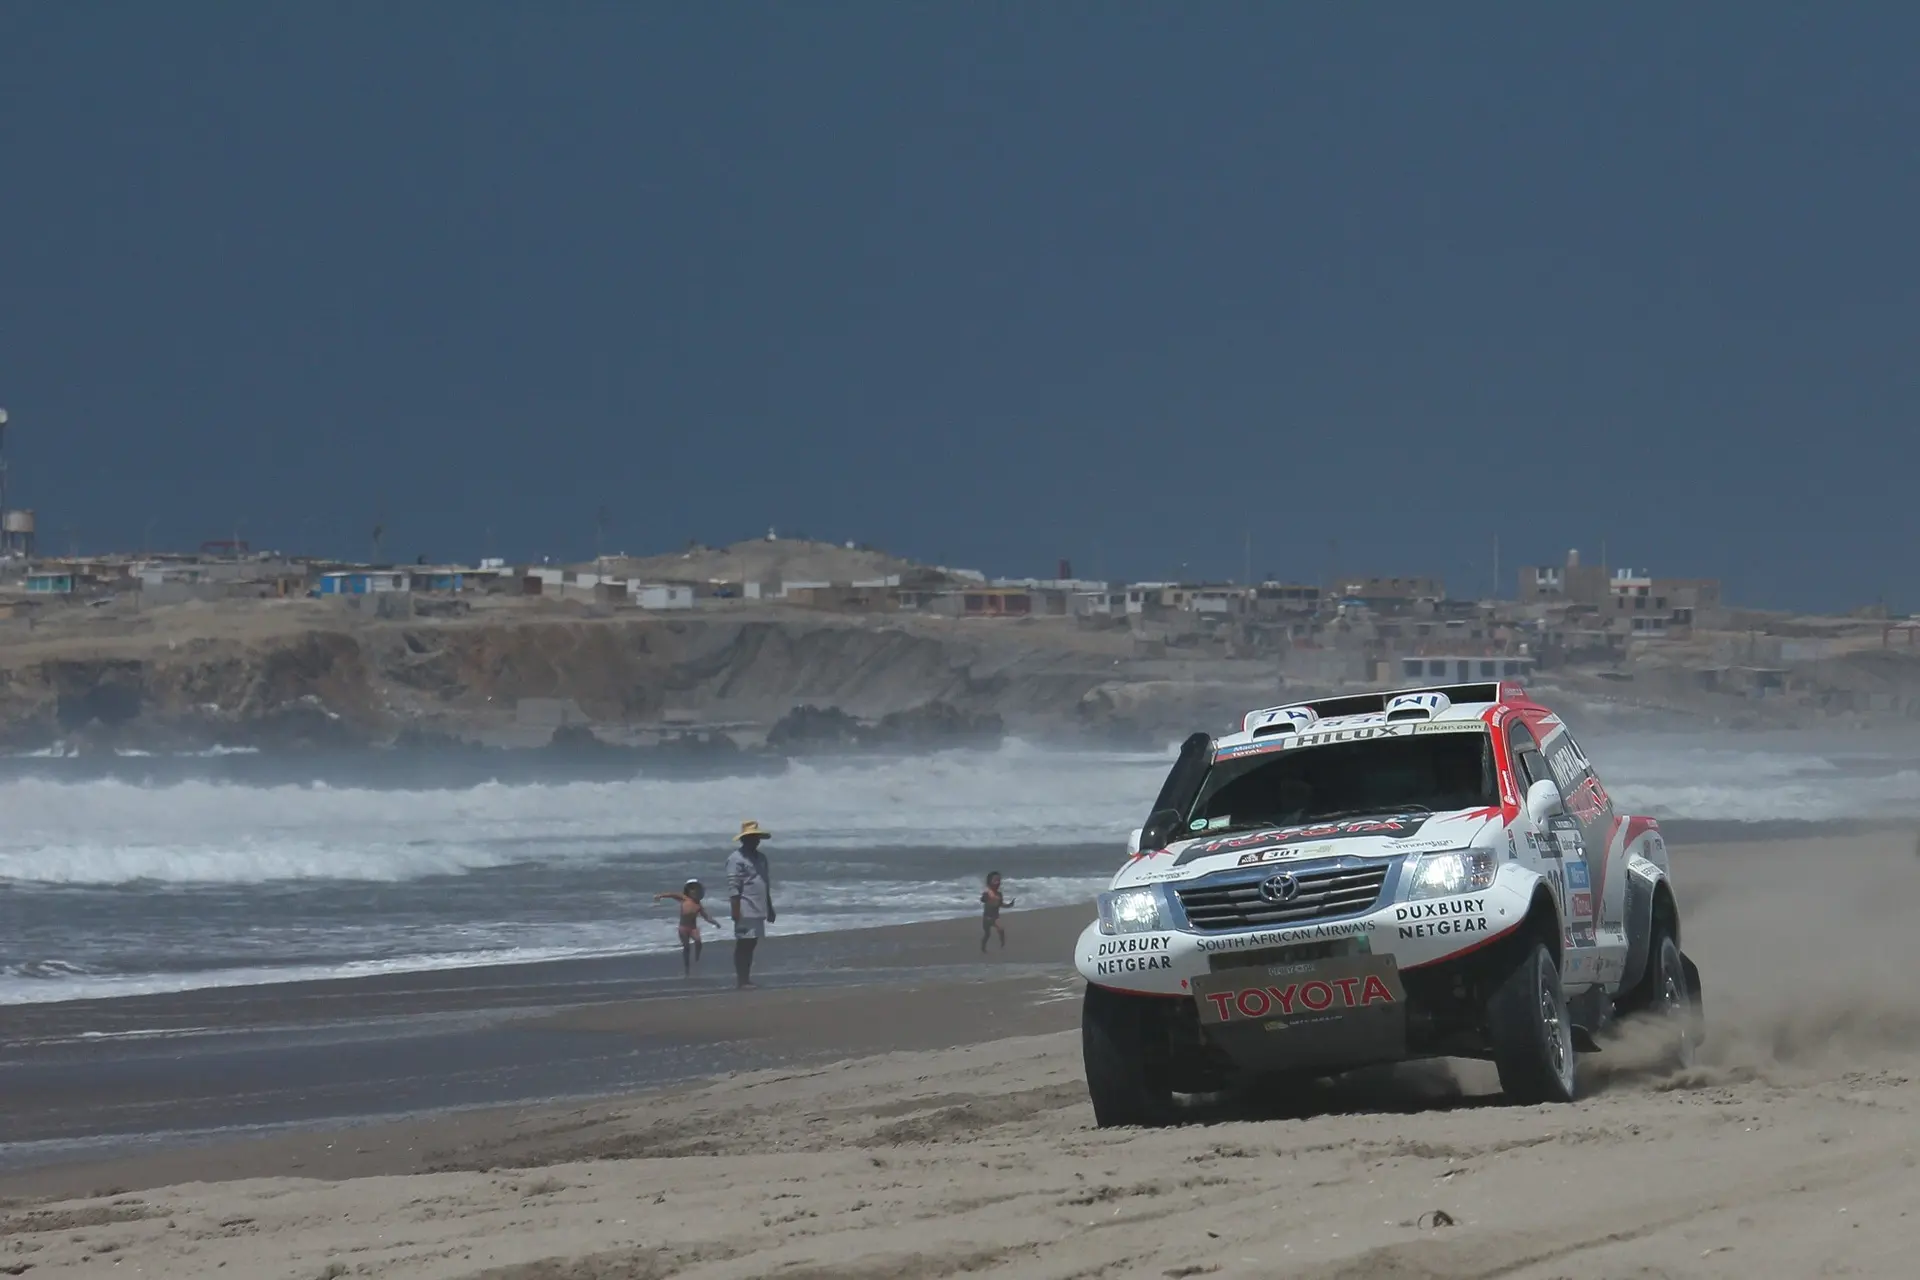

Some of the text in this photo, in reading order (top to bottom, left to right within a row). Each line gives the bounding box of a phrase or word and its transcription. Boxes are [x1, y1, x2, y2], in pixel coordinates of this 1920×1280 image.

[1296, 726, 1399, 747] HILUX
[1419, 723, 1482, 732] dakar.com
[1231, 748, 1263, 758] TOTAL
[1268, 849, 1300, 859] 301
[1396, 899, 1486, 920] DUXBURY
[1196, 919, 1376, 952] SOUTH AFRICAN AIRWAYS
[1398, 917, 1489, 939] NETGEAR
[1098, 936, 1171, 956] DUXBURY
[1097, 955, 1172, 976] NETGEAR
[1205, 974, 1396, 1022] TOYOTA
